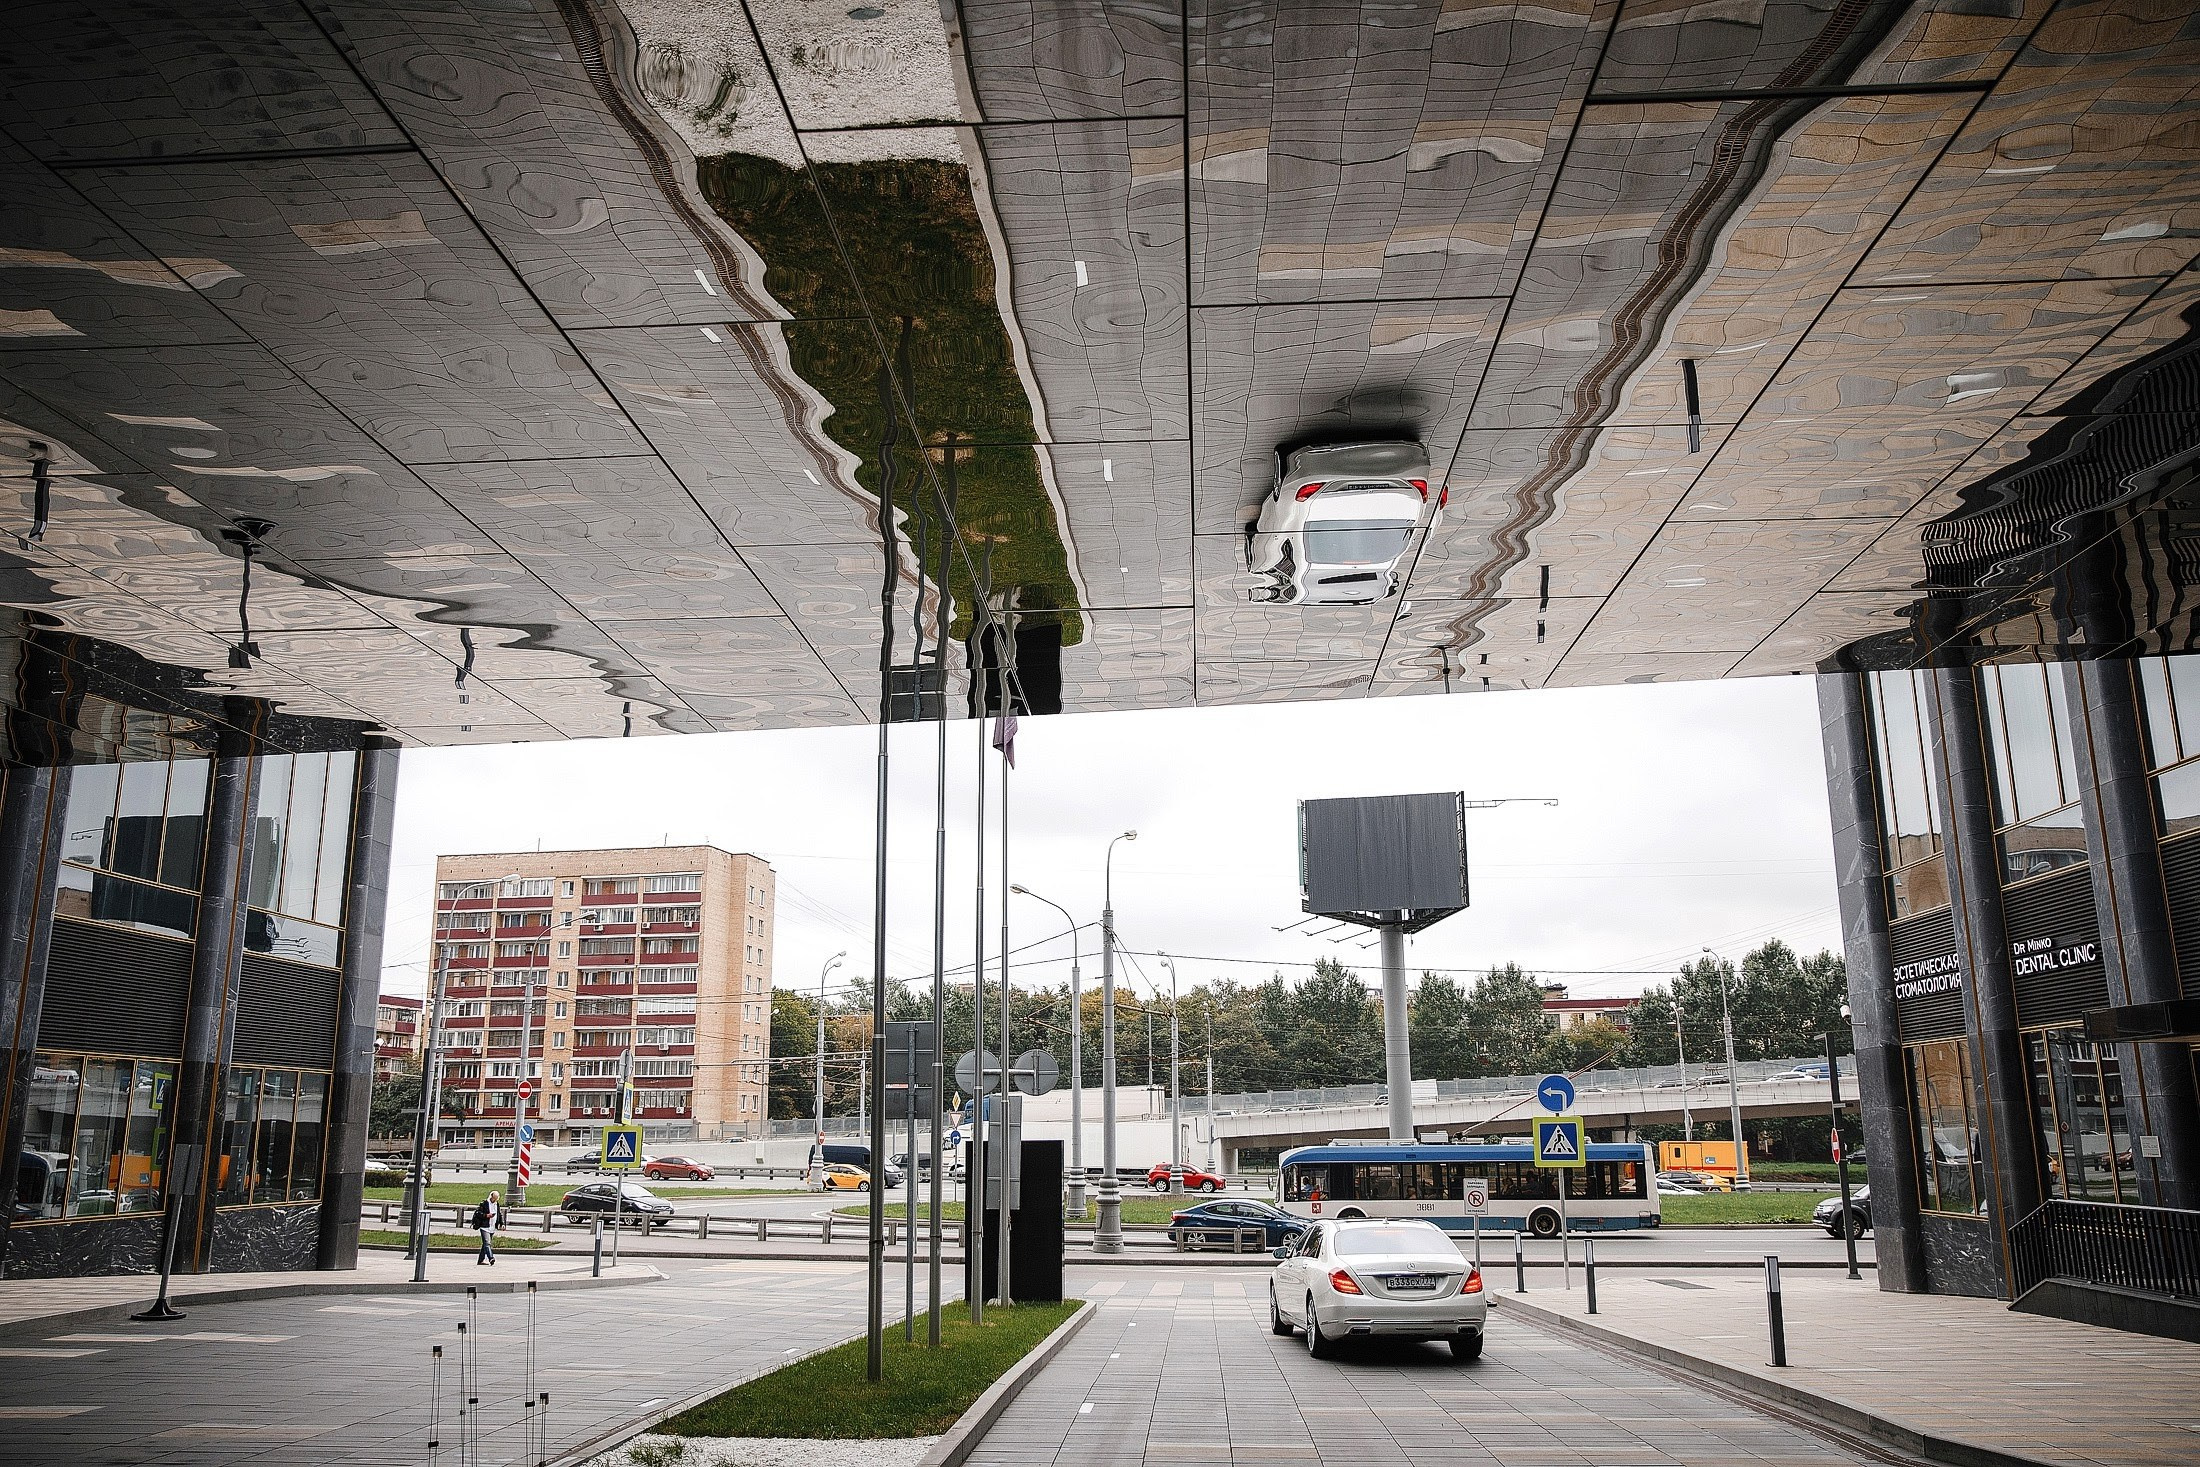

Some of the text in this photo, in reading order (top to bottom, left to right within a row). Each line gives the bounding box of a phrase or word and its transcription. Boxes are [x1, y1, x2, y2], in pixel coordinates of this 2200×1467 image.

[1893, 953, 1960, 982] ЭСТЕТИЧЕСКАЯ
[2015, 943, 2096, 976] DENTAL CLINIC
[1895, 972, 1962, 999] СТОМАТОЛОГИЯ
